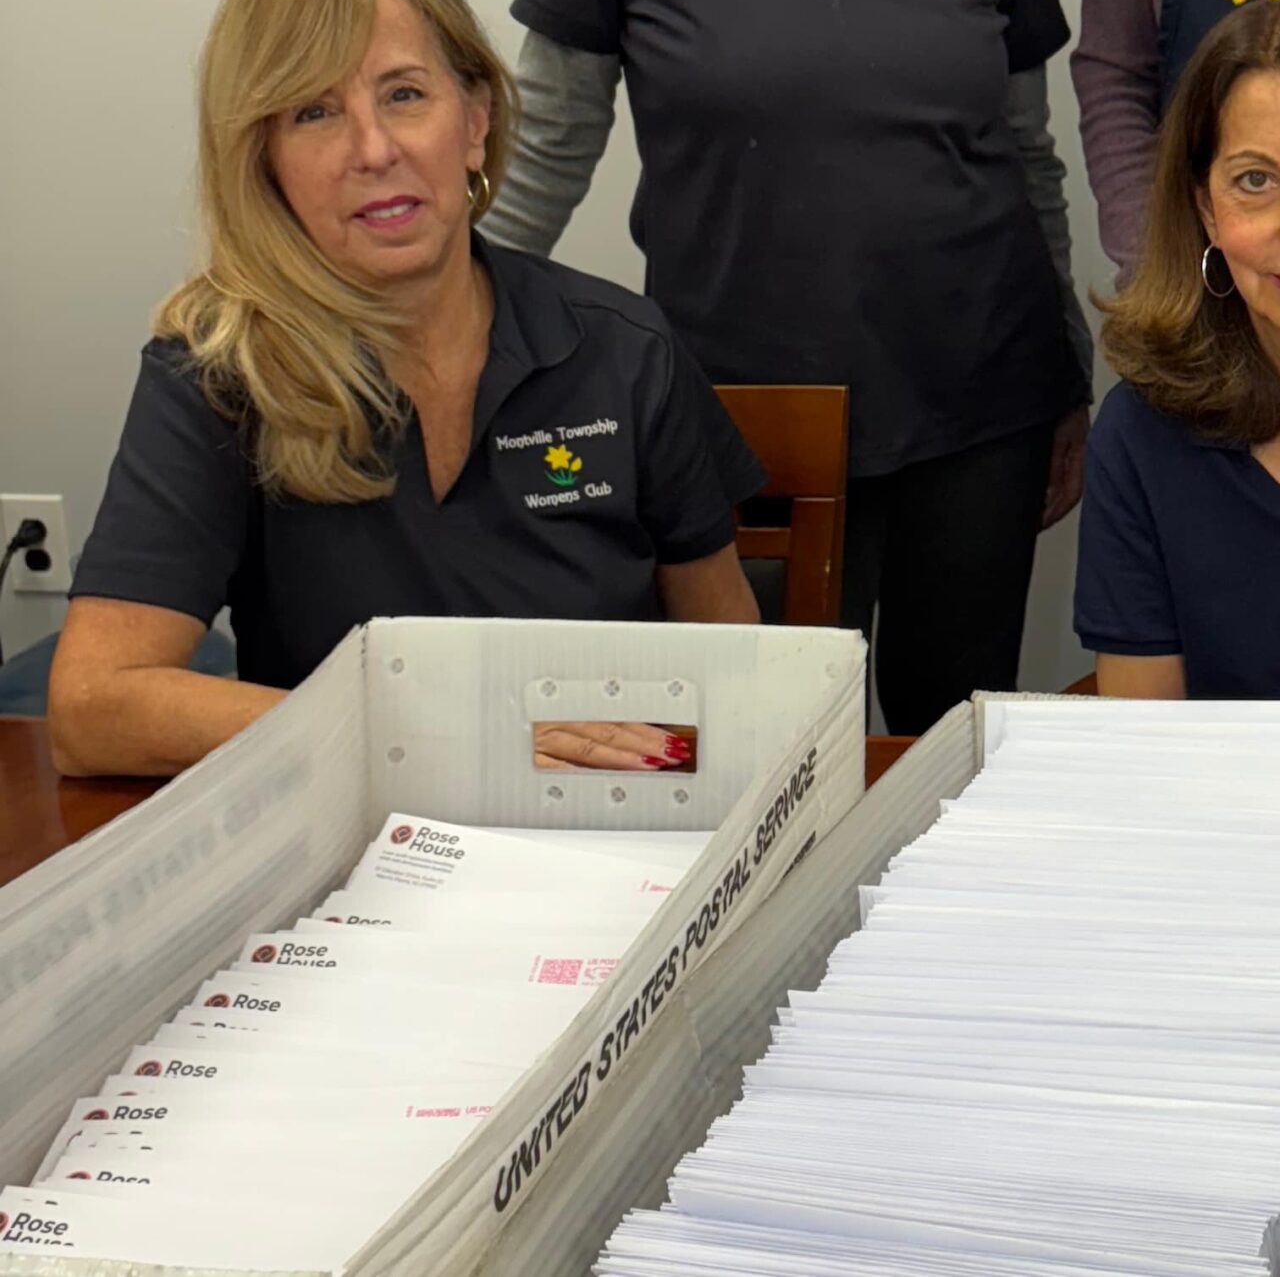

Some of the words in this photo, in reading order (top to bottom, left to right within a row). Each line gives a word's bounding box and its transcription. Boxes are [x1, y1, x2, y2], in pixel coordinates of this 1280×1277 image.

[496, 430, 553, 450] Montville
[556, 418, 618, 441] Township
[524, 490, 581, 509] Womens
[584, 481, 613, 498] Club
[415, 826, 460, 845] Rose
[408, 838, 466, 860] House
[280, 943, 328, 957] Rose
[494, 1060, 592, 1213] UNITED
[596, 945, 680, 1082] STATES
[682, 847, 752, 971] POSTAL
[753, 746, 818, 866] SERVICE
[232, 993, 282, 1012] Rose
[165, 1060, 218, 1078] Rose
[113, 1105, 168, 1120] Rose
[11, 1212, 69, 1236] Rose
